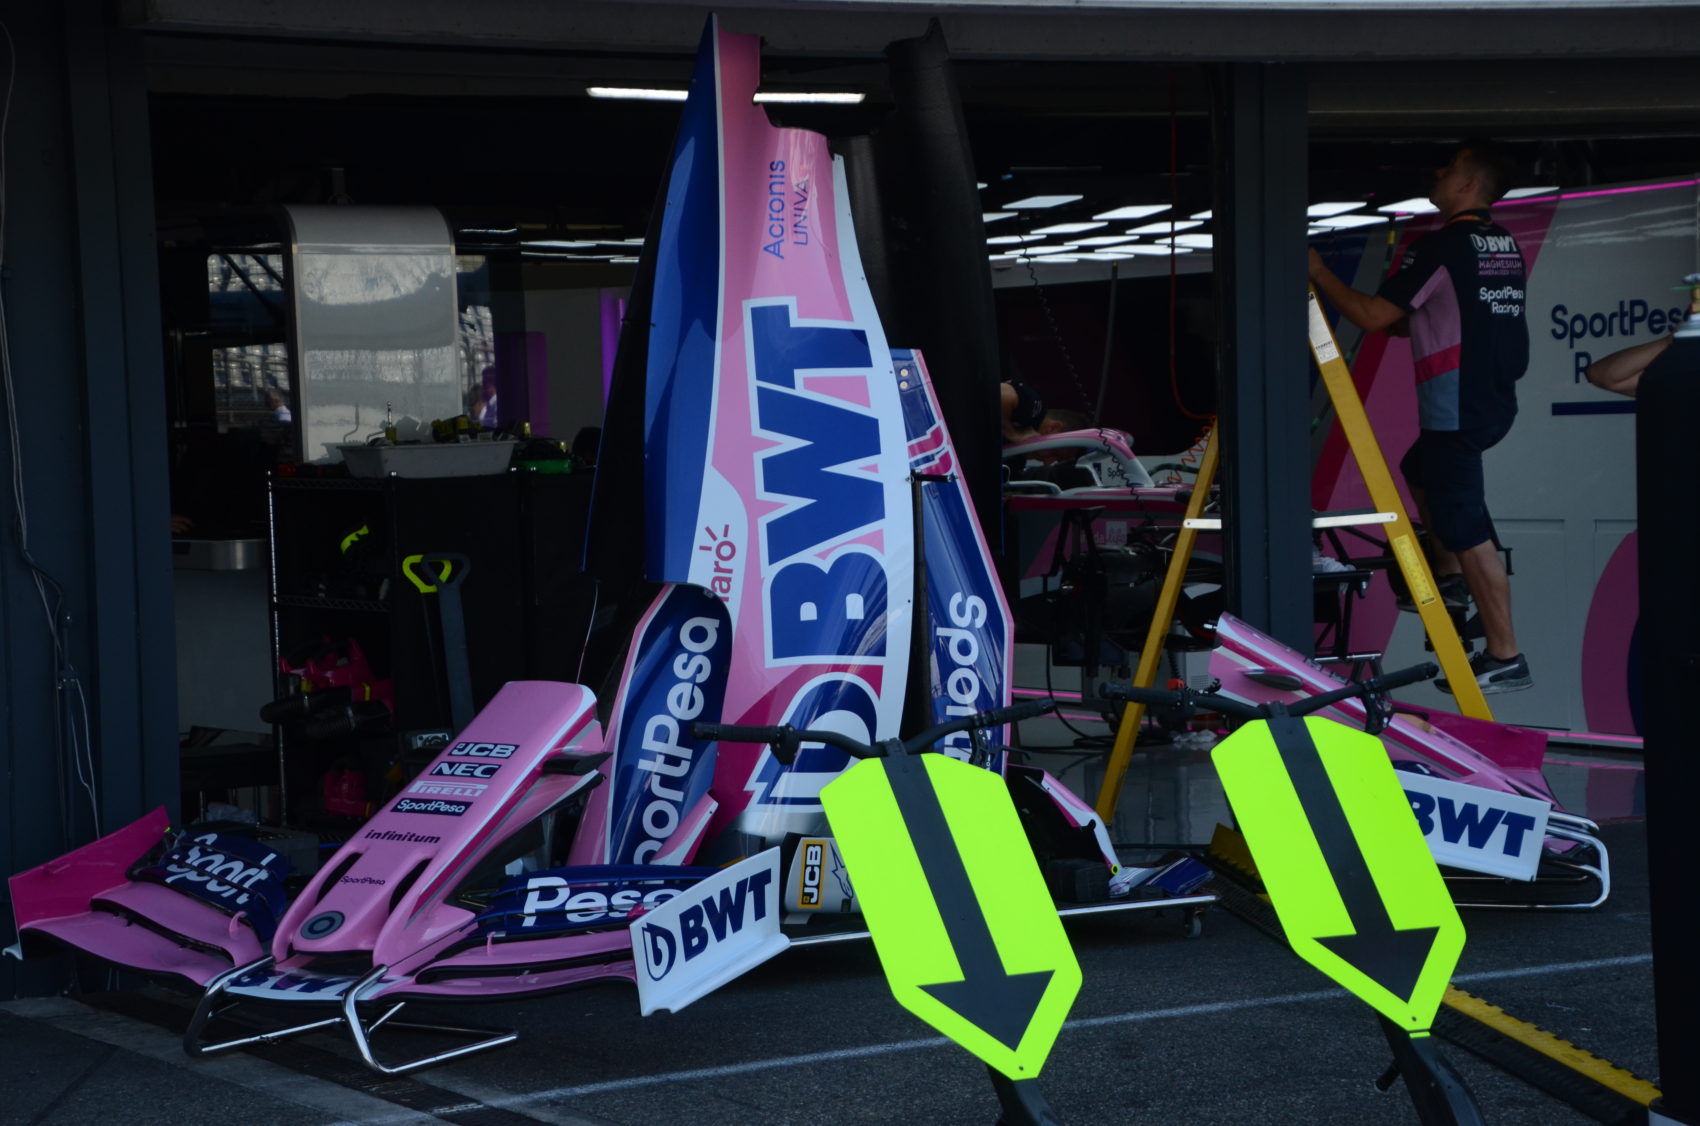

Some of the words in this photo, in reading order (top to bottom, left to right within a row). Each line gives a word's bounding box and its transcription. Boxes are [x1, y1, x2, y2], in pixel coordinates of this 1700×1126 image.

[763, 160, 785, 259] Acronis
[793, 179, 808, 245] UNIVA
[1492, 302, 1520, 317] Racing
[751, 304, 888, 660] BWT
[451, 742, 516, 757] JCB
[431, 761, 501, 778] NEC
[408, 780, 489, 797] PIRELLI
[397, 799, 466, 814] SportPesa
[365, 829, 440, 844] infinitum
[165, 833, 277, 905] Sport
[803, 845, 822, 904] JCB
[340, 875, 385, 886] SportPesa
[679, 868, 772, 962] BWT
